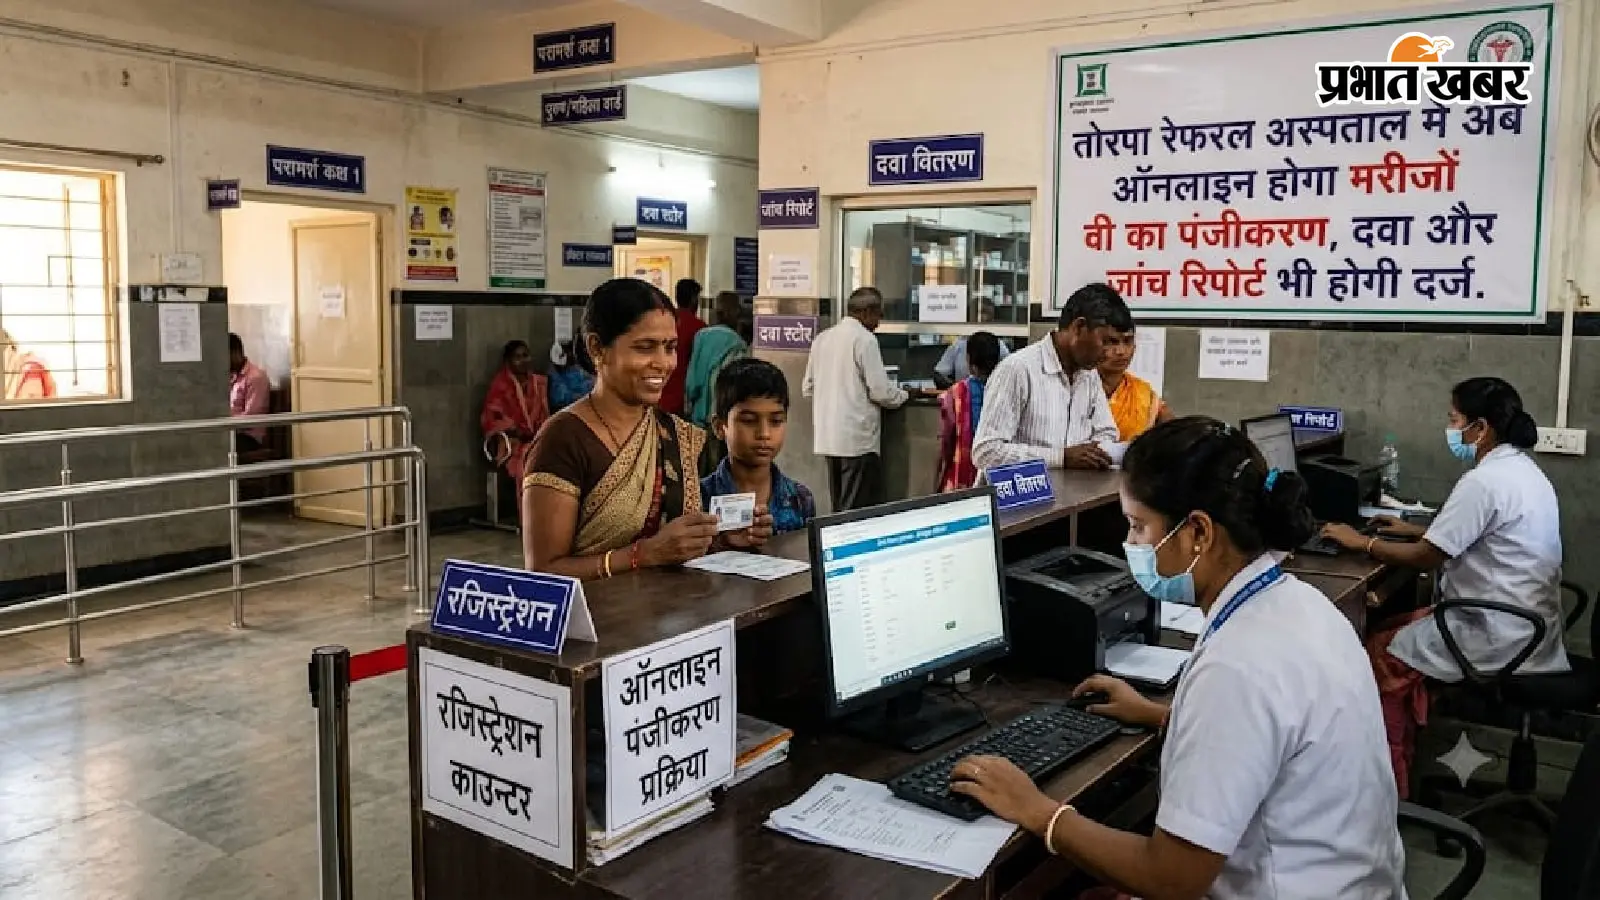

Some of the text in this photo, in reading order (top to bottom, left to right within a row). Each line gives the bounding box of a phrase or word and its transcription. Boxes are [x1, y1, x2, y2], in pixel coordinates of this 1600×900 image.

[1072, 121, 1152, 158] तोरपा
[1160, 116, 1256, 153] रेफरल
[1266, 110, 1411, 147] अस्पताल
[1462, 103, 1527, 135] अब
[353, 166, 360, 185] 1
[875, 145, 975, 176] दवा वितरण
[1112, 149, 1460, 204] ऑनलाइन होगा मरीजों
[1083, 201, 1498, 253] वी का पंजीकरण, दवा और
[1106, 255, 1485, 302] जांच रिपोर्ट भी होगी दर्ज.
[759, 321, 813, 343] दवा स्टोर
[447, 579, 556, 633] रजिस्ट्रेशन
[619, 646, 722, 706] ऑनलाइन
[437, 685, 544, 758] रजिस्ट्रेशन
[624, 695, 721, 756] पंजीकरण
[450, 759, 532, 821] काउन्टर
[639, 747, 709, 805] प्रक्रिया
